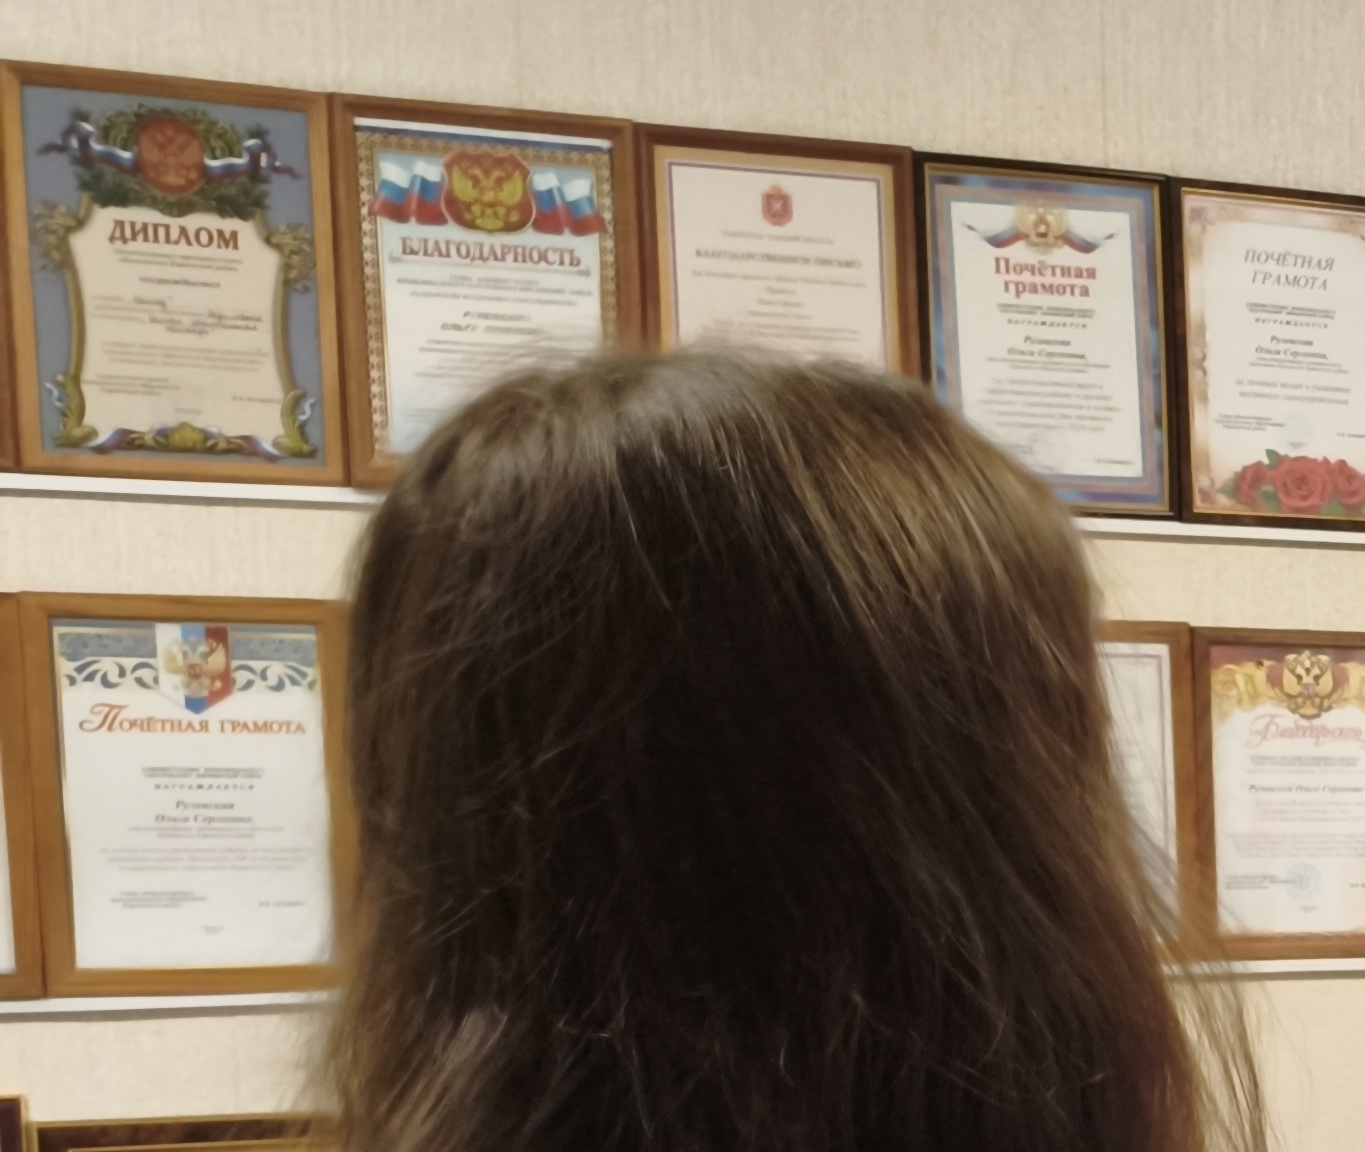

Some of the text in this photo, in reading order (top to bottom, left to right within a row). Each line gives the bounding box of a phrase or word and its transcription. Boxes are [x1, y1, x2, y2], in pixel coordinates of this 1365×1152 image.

[107, 218, 240, 251] ДИПЛОМ
[400, 237, 581, 268] БЛАГОДАРНОСТЬ
[994, 256, 1097, 280] Почётная
[1003, 279, 1090, 298] грамота
[1251, 270, 1329, 291] ГРАМОТА
